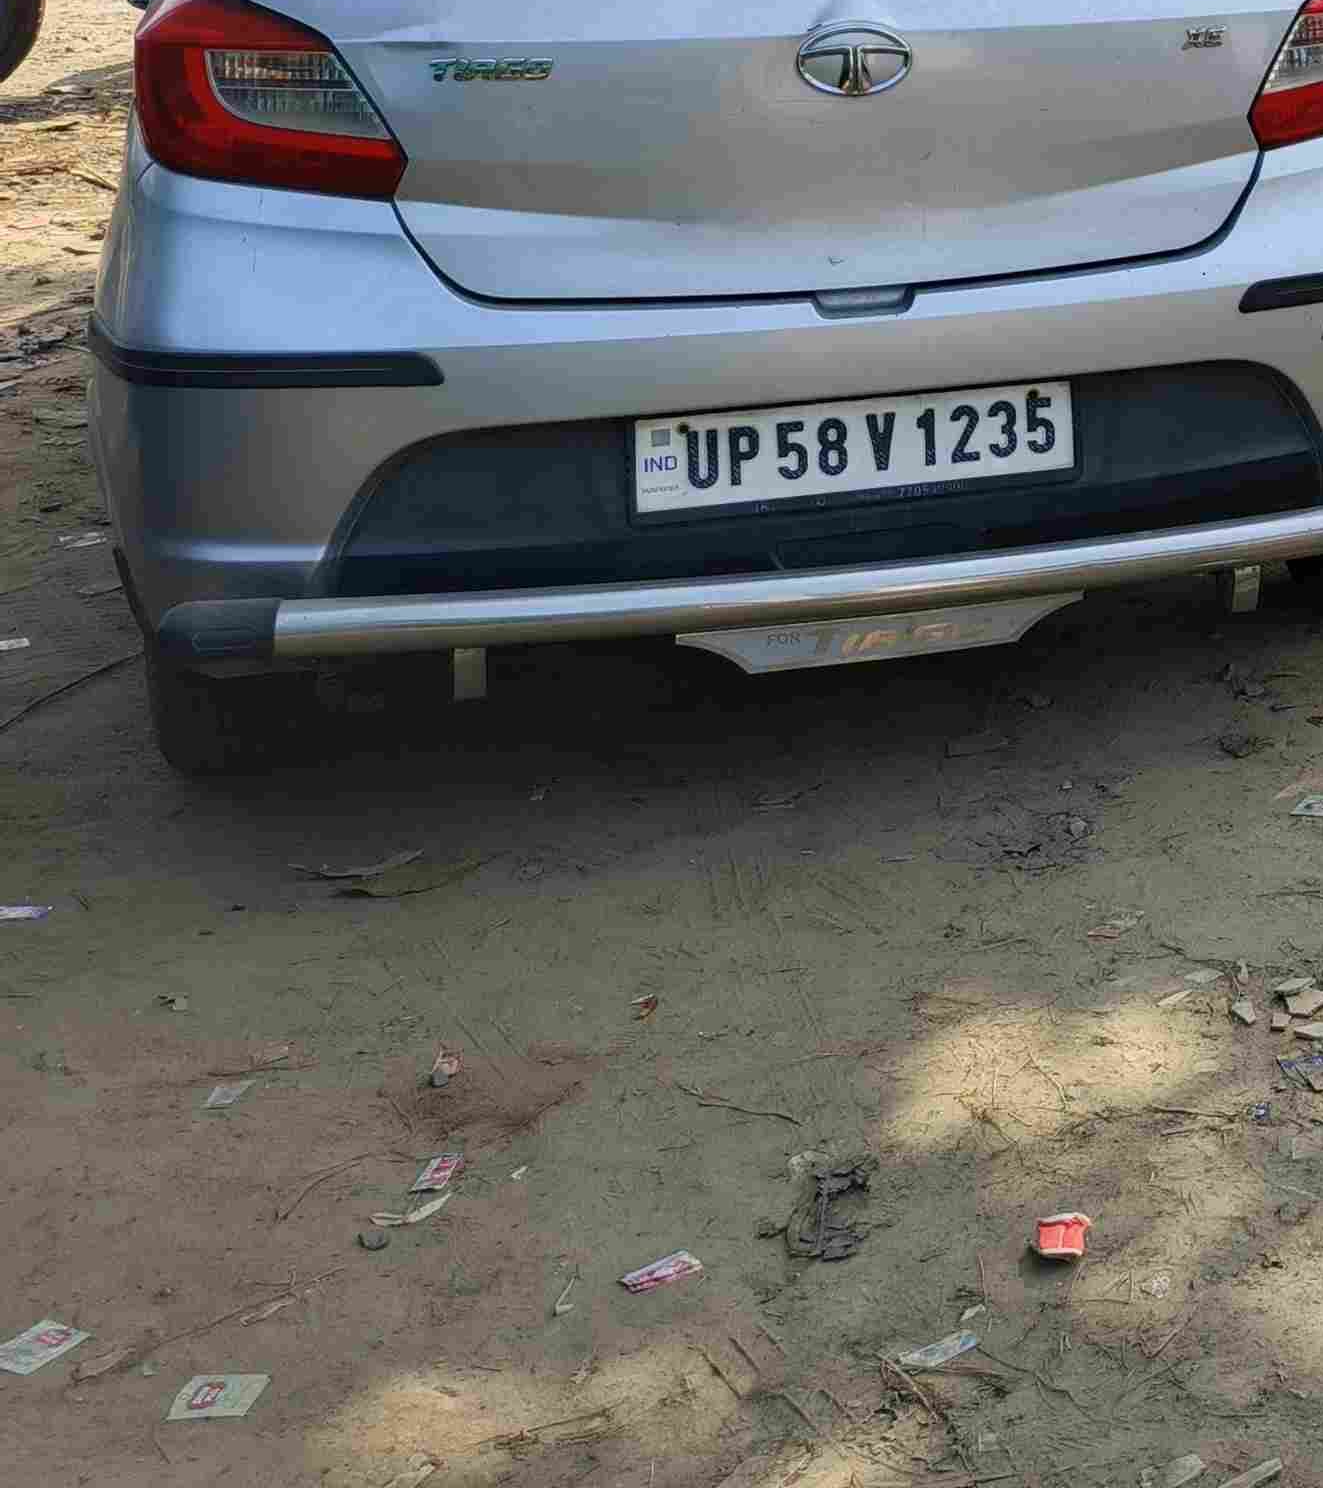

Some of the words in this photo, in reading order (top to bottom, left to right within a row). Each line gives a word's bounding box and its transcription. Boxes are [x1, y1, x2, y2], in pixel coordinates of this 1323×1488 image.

[643, 455, 678, 473] IND
[685, 426, 761, 489] UP
[775, 417, 849, 481] 58
[865, 411, 897, 472] V
[915, 396, 1057, 467] 1235
